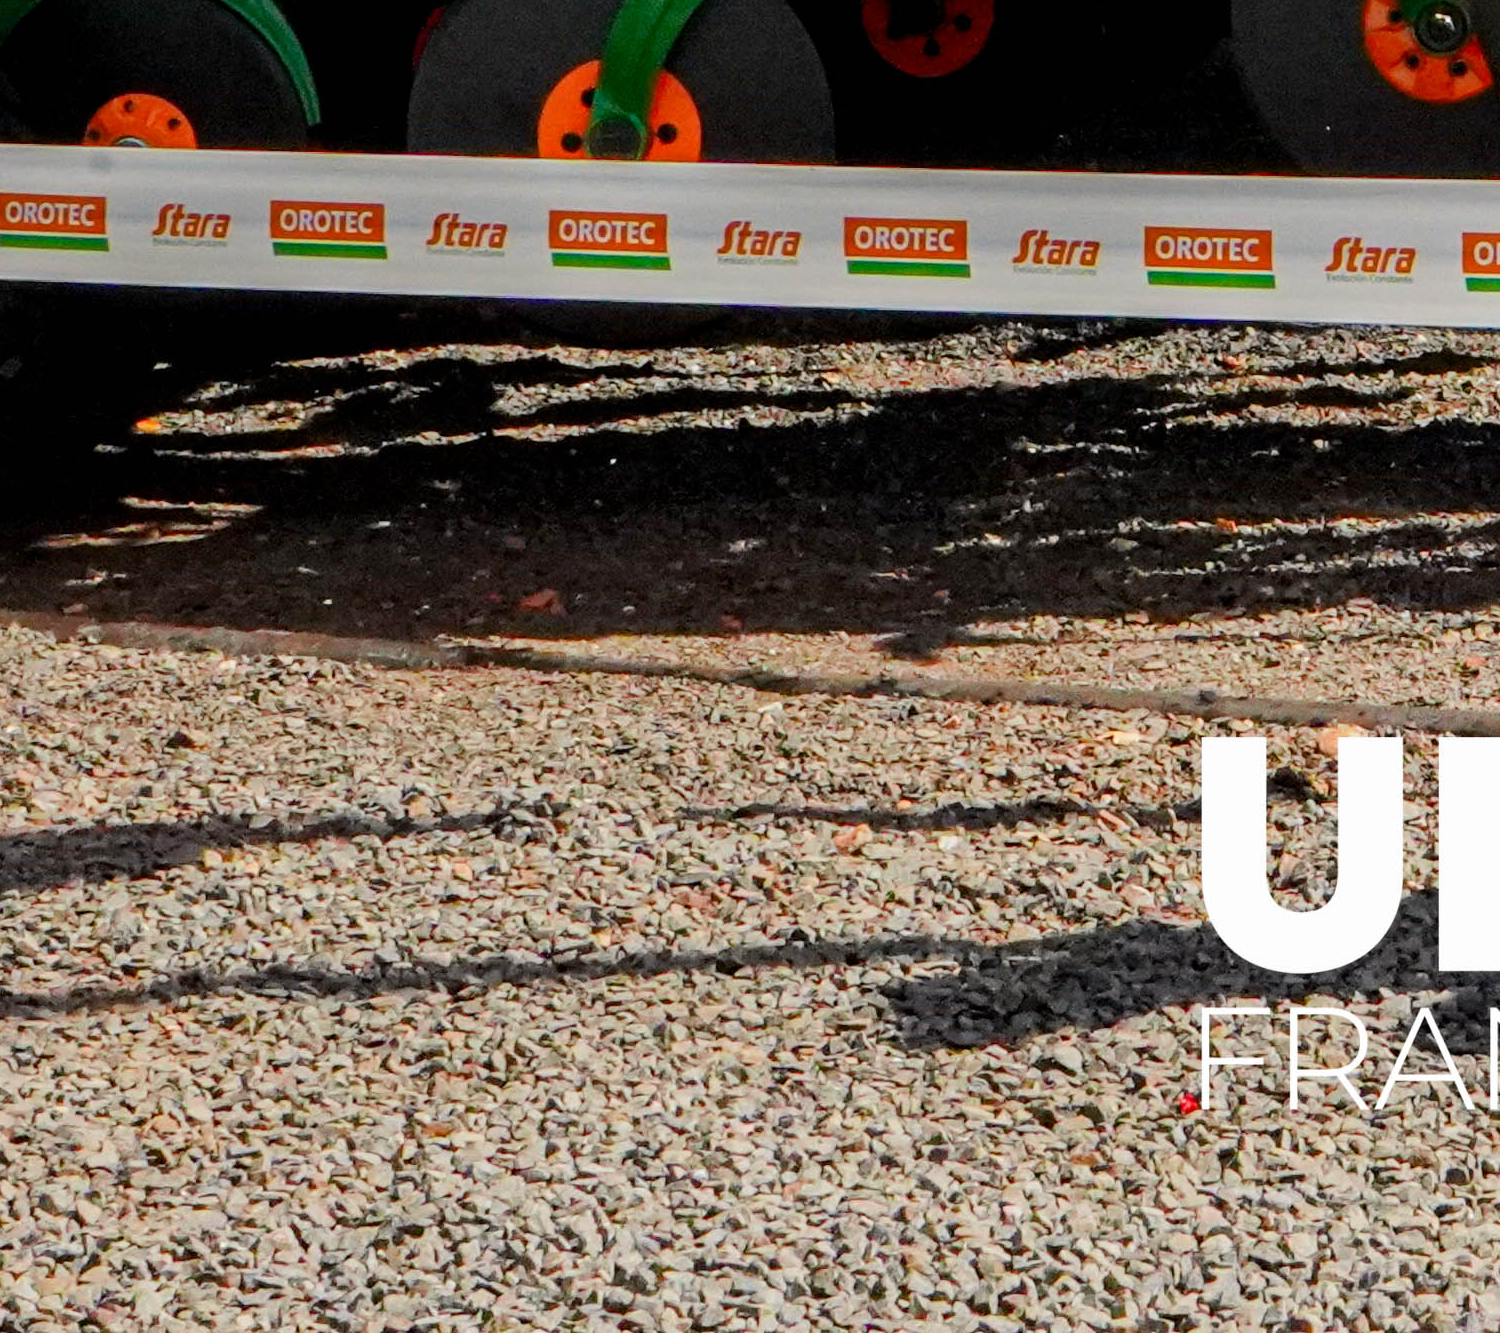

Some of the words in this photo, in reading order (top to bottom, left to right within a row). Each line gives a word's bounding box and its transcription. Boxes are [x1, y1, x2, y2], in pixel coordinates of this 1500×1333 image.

[5, 201, 96, 227] OROTEC
[153, 204, 231, 239] Stara
[278, 209, 373, 235] OROTEC
[427, 213, 508, 248] Stara
[558, 219, 656, 245] OROTEC
[717, 221, 802, 257] Stara
[854, 225, 955, 253] OROTEC
[1013, 229, 1101, 266] Stara
[1155, 235, 1260, 262] OROTEC
[1326, 237, 1417, 275] Stara
